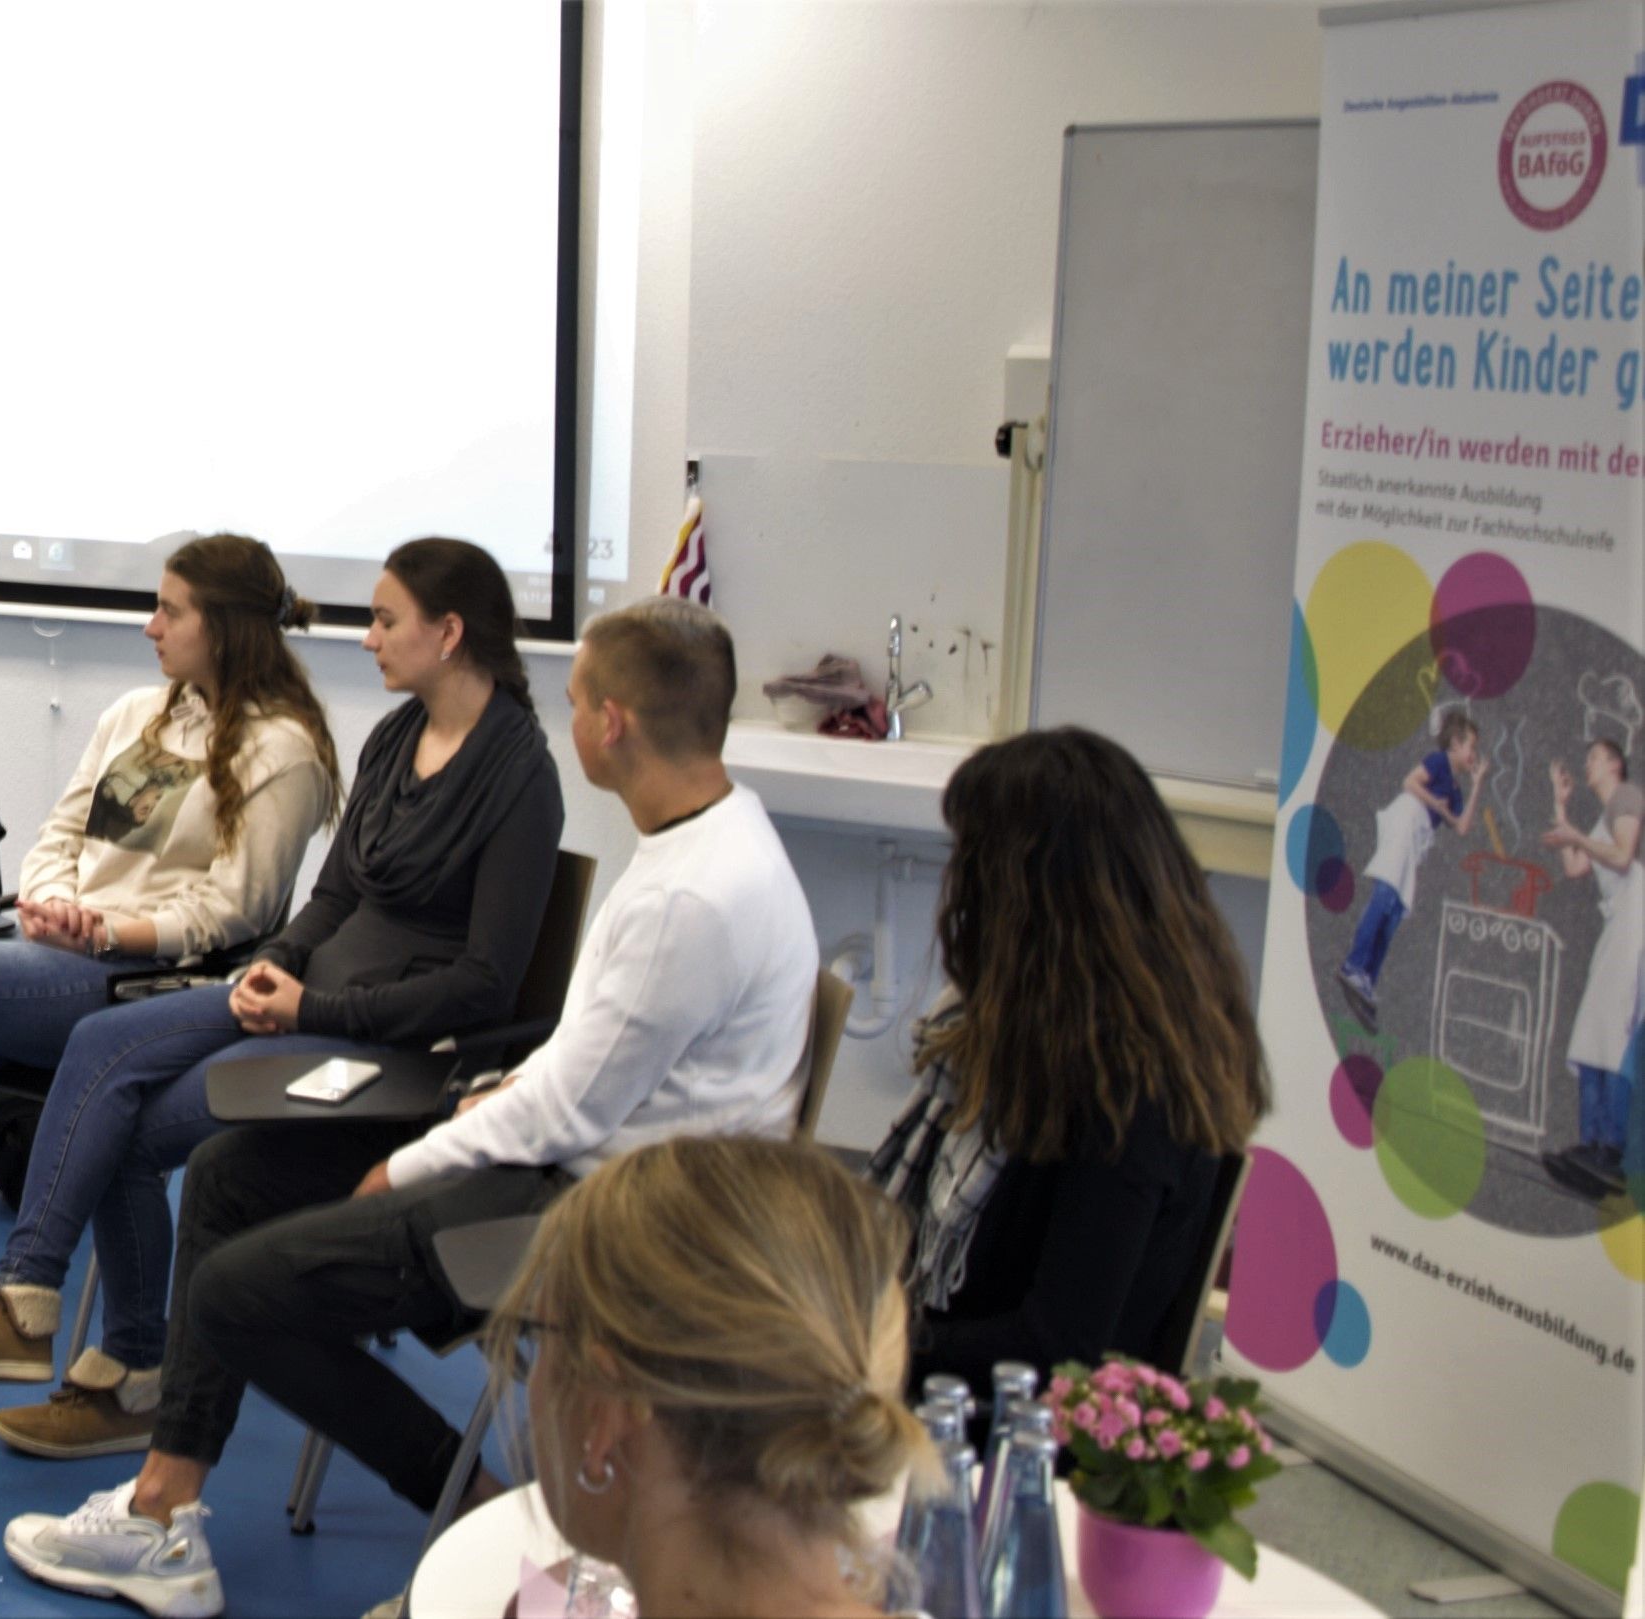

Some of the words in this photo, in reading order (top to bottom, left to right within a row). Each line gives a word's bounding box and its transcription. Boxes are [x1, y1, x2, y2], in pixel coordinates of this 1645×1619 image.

[1518, 151, 1584, 178] BAföG
[1330, 256, 1371, 314] An
[1386, 259, 1520, 318] meiner
[1535, 255, 1641, 321] Seite
[1327, 326, 1456, 389] werden
[1473, 328, 1599, 397] Kinder
[1321, 420, 1451, 461] Erzieher/in
[1458, 435, 1550, 469] werden
[1557, 442, 1599, 474] mit
[1317, 469, 1374, 493] Staatlich
[1376, 474, 1457, 499] anerkannte
[1460, 484, 1543, 513] Ausbildung
[1315, 499, 1335, 515] mit
[1337, 501, 1358, 519] der
[1360, 504, 1443, 530] Möglichkeit
[1446, 518, 1469, 532] zur
[1472, 516, 1615, 552] Fachhochschulreife
[1370, 1233, 1636, 1374] www.daa-erzieherausbildung.de
